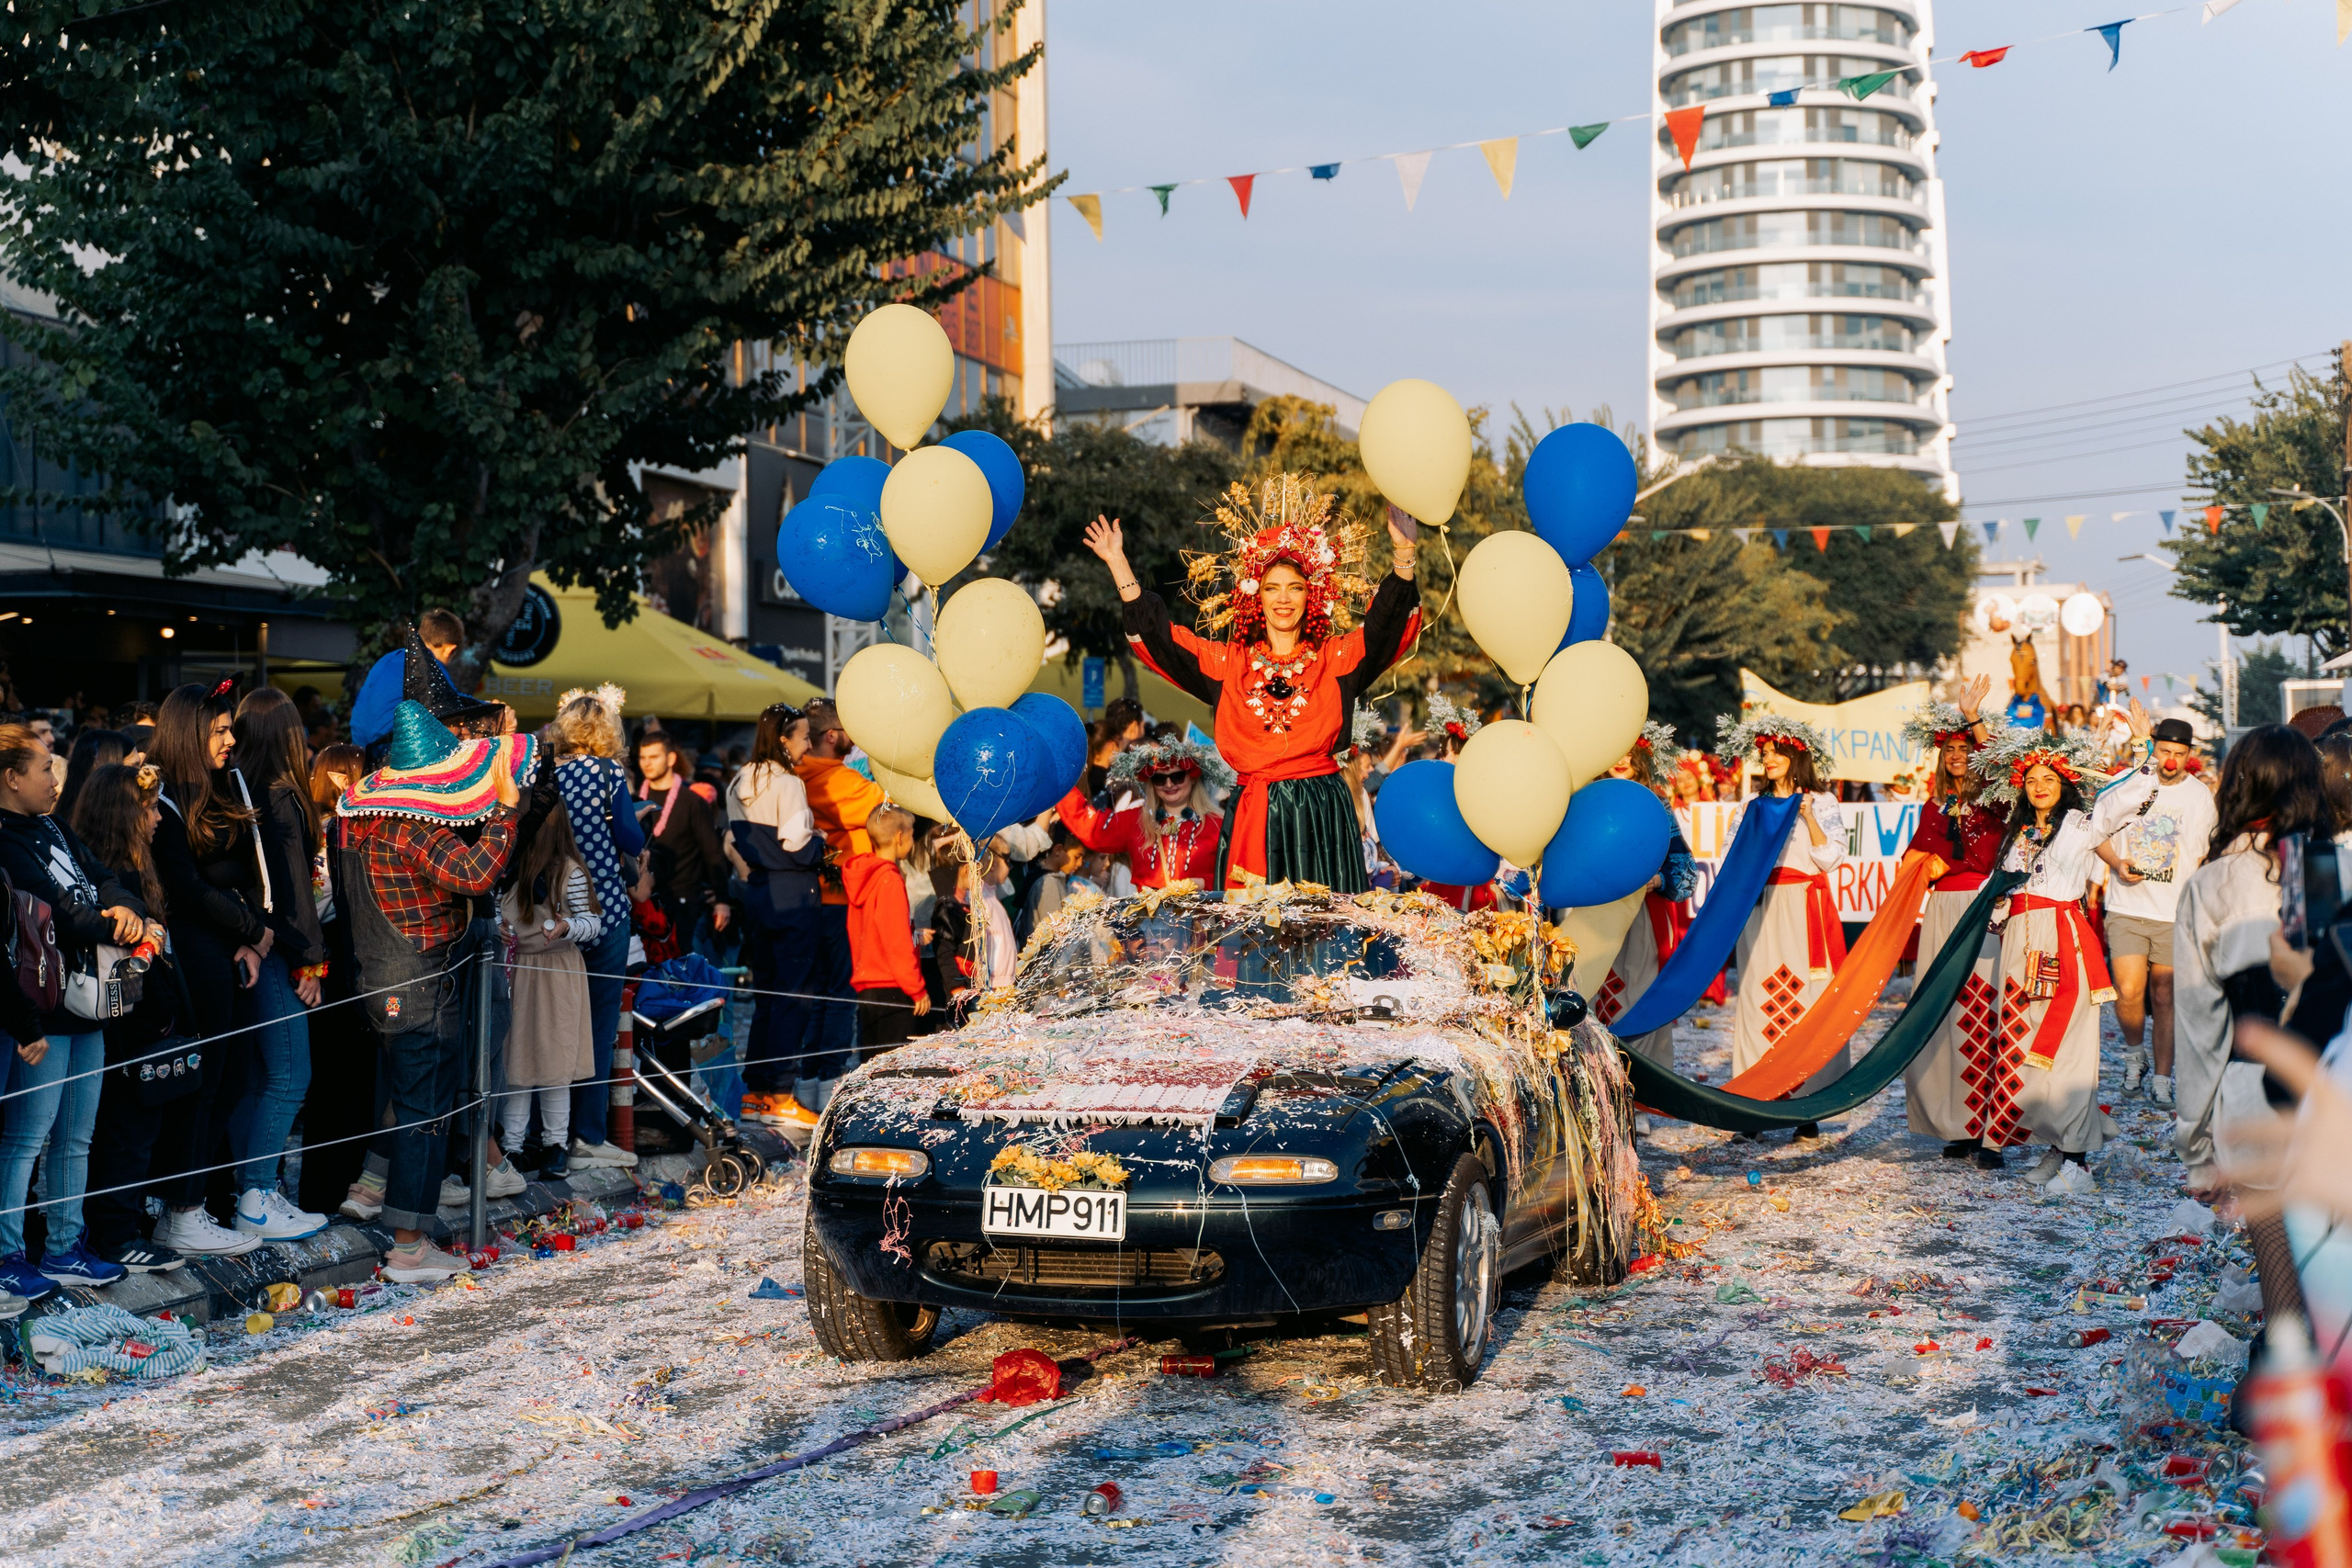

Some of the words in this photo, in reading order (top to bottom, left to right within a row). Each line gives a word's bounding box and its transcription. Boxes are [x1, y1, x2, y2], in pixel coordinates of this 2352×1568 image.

[484, 677, 553, 696] BEER
[1845, 811, 1864, 857] ill
[1838, 861, 1901, 912] RKN
[109, 984, 119, 1018] GUESS
[989, 1190, 1120, 1234] HMP911
